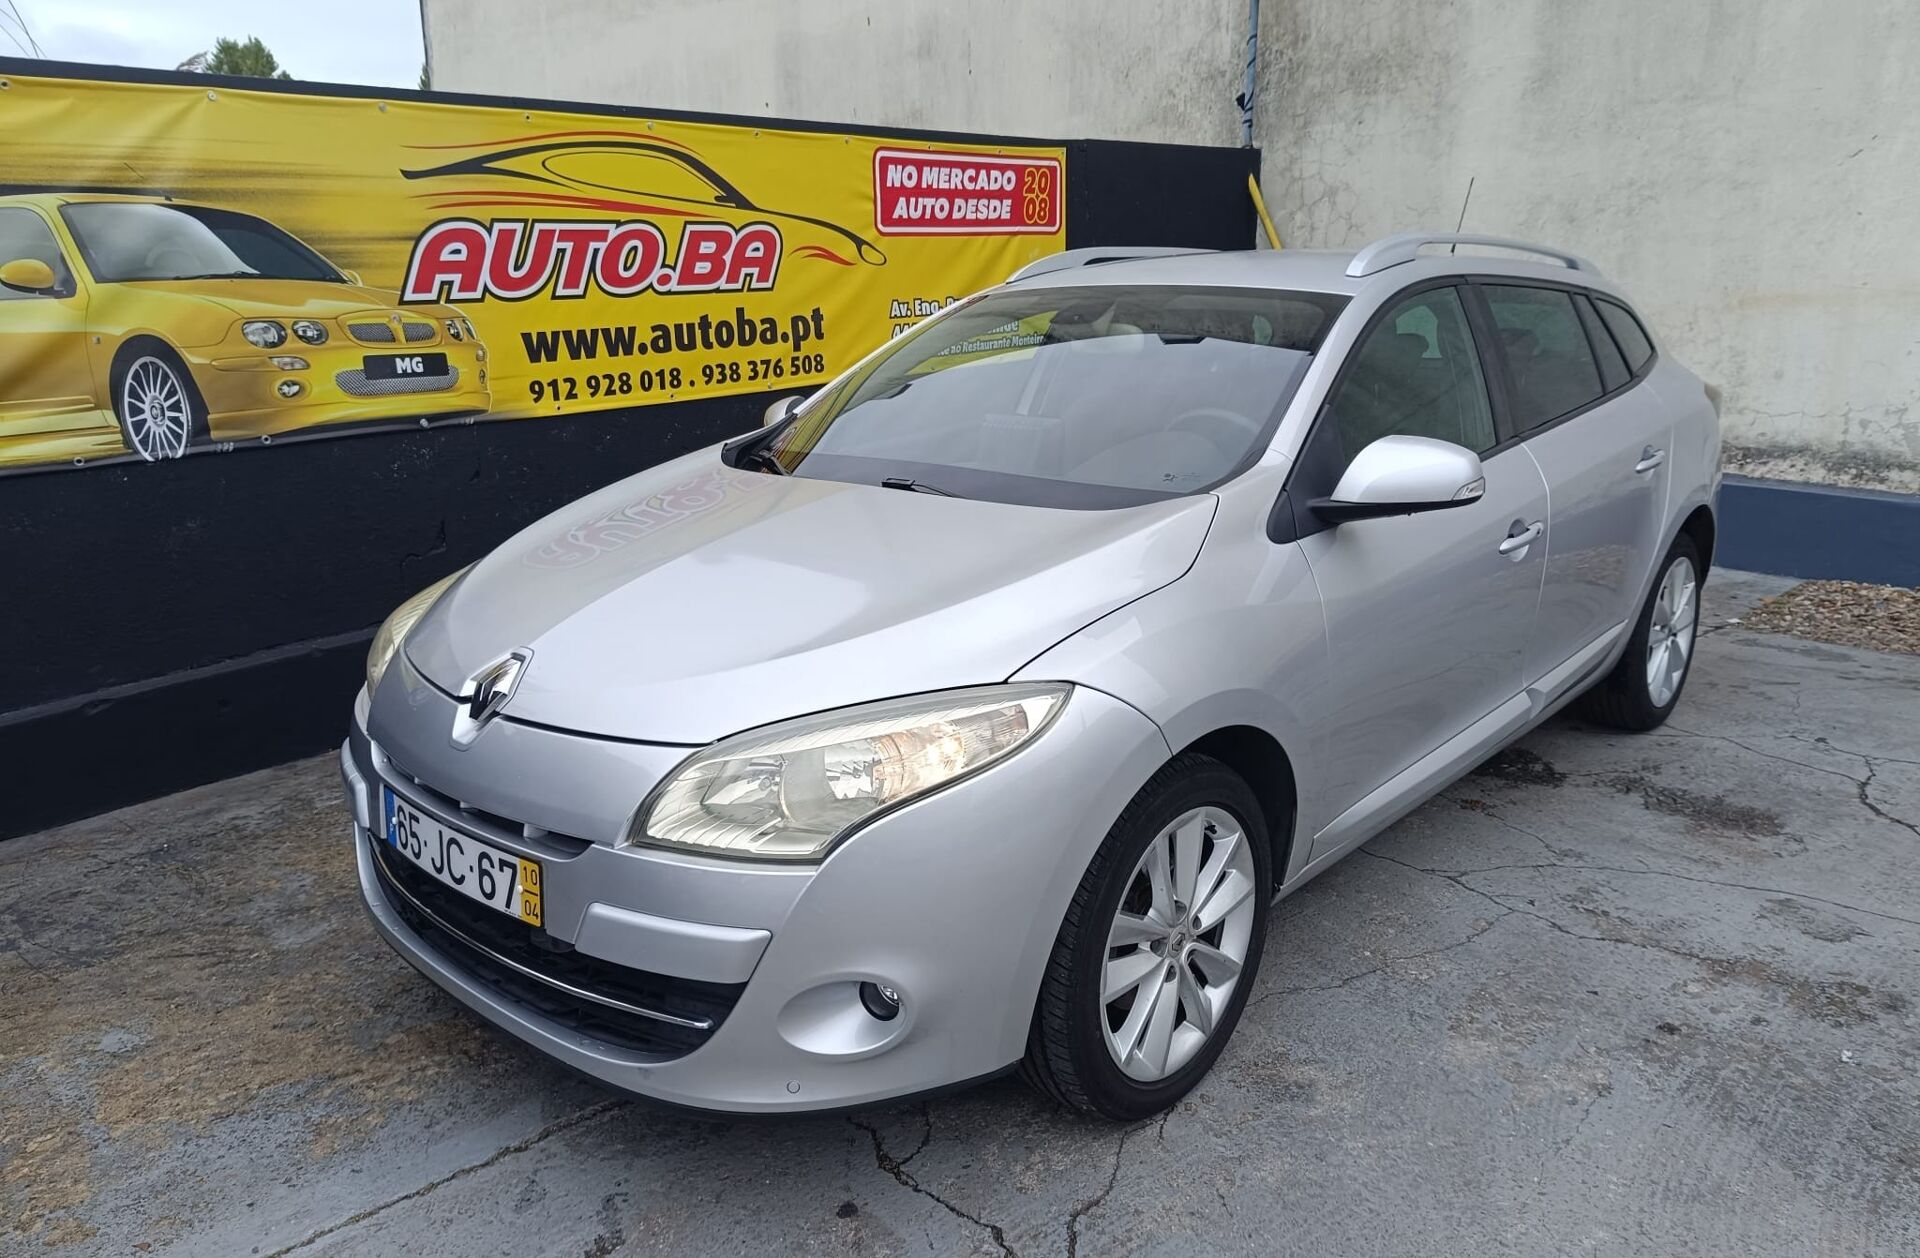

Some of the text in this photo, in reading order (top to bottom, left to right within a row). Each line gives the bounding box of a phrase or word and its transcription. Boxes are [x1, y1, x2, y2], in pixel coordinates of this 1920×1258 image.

[886, 164, 1017, 191] NO MERCADO
[892, 196, 1013, 220] AUTO DESDE
[400, 218, 783, 304] AUTO.BA
[889, 299, 912, 319] Av.
[520, 307, 825, 364] www.autoba.pt
[962, 337, 1011, 353] Restaurante
[394, 355, 424, 374] MG
[529, 378, 579, 404] 912
[586, 372, 634, 398] 928
[639, 368, 682, 393] 018
[701, 361, 742, 387] 938
[747, 357, 784, 382] 376
[789, 353, 826, 376] 508
[522, 866, 538, 886] 10
[524, 899, 540, 920] 04
